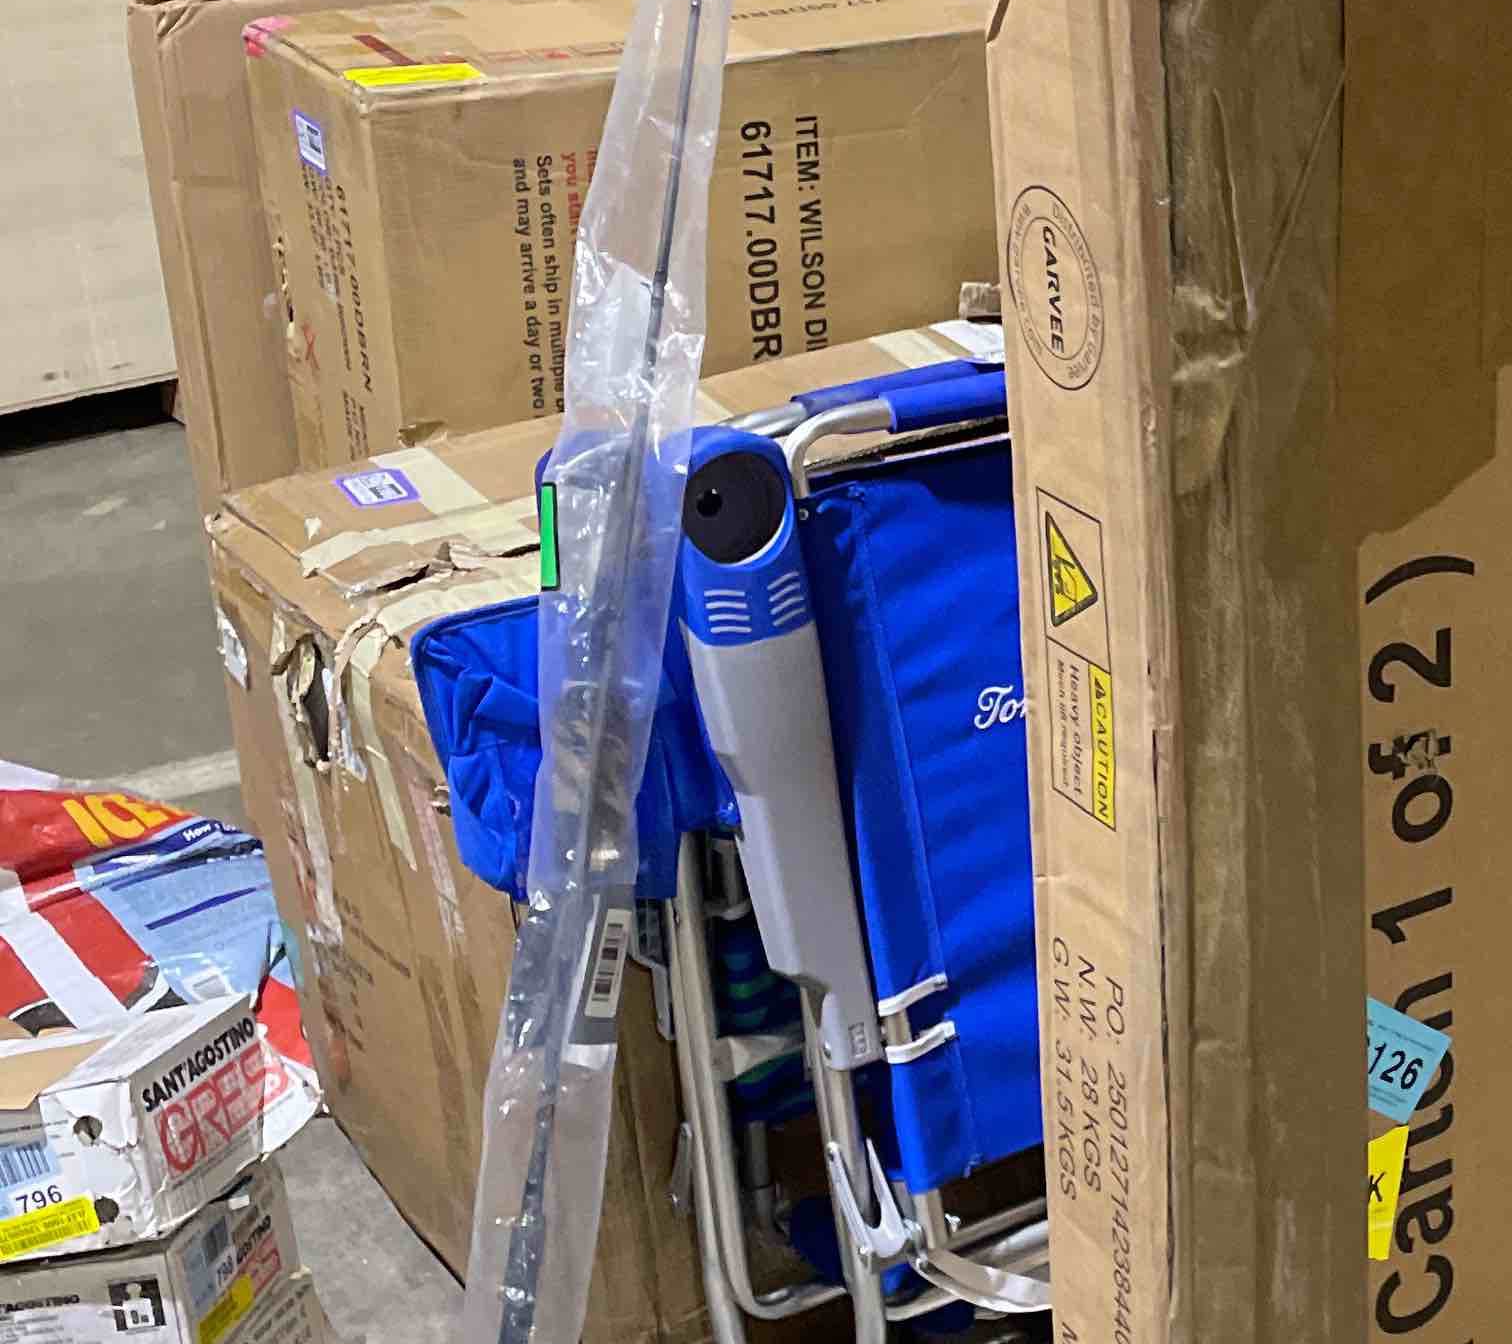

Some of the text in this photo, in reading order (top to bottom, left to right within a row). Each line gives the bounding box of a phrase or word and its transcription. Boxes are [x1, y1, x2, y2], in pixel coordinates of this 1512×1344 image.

[536, 155, 554, 197] Sets
[560, 151, 578, 187] you
[795, 115, 820, 191] ITEM:
[538, 202, 558, 250] often
[799, 198, 827, 311] WILSON
[513, 158, 547, 410] and may arrive a day or two
[542, 255, 562, 294] ship
[547, 298, 564, 316] in
[1042, 225, 1065, 354] GARVEE
[1367, 627, 1451, 703] 2
[1069, 663, 1085, 795] Heavy object
[1096, 702, 1110, 819] CAUTION
[1370, 886, 1451, 946] 1
[1104, 975, 1125, 1046] PO:
[142, 1016, 256, 1113] SANT'AGOSTINO
[159, 1044, 289, 1174] GRES
[15, 1184, 64, 1217] 796
